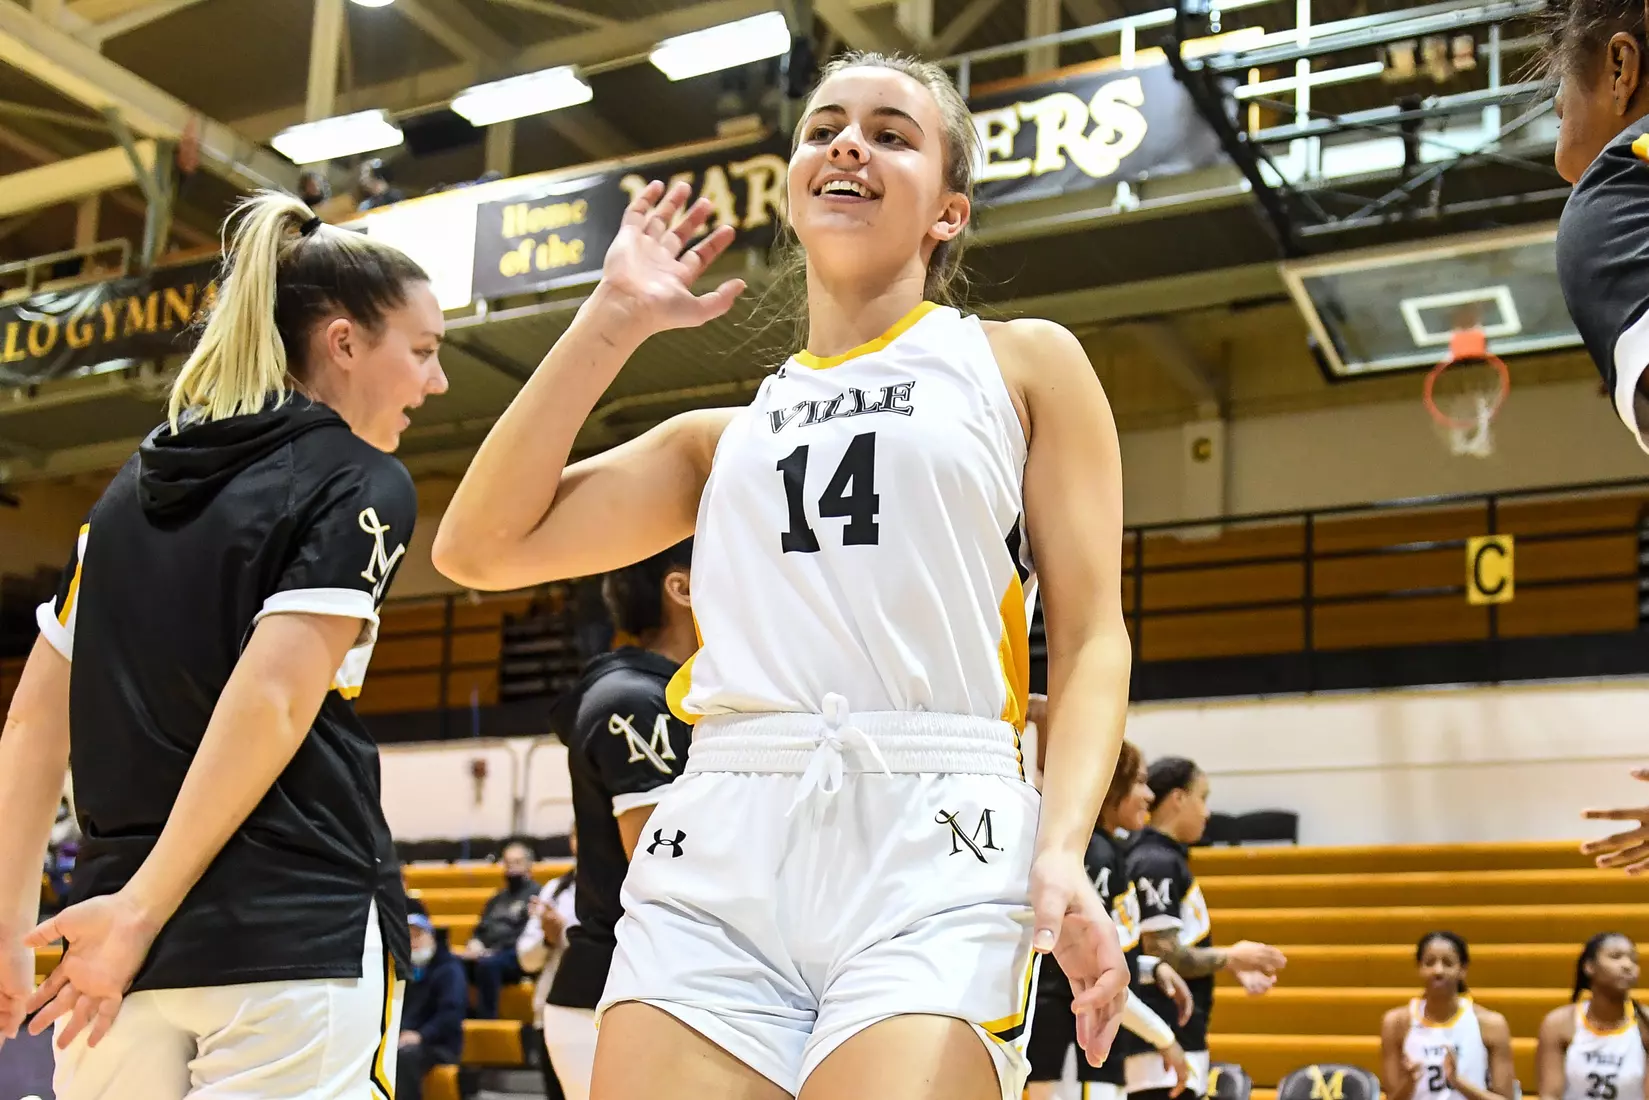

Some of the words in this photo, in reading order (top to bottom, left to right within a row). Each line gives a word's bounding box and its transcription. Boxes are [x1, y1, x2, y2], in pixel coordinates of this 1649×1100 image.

[502, 199, 588, 239] Home
[499, 238, 536, 277] of
[535, 234, 586, 271] the
[766, 381, 916, 434] VILLE
[776, 431, 880, 554] 14
[1474, 542, 1507, 596] C
